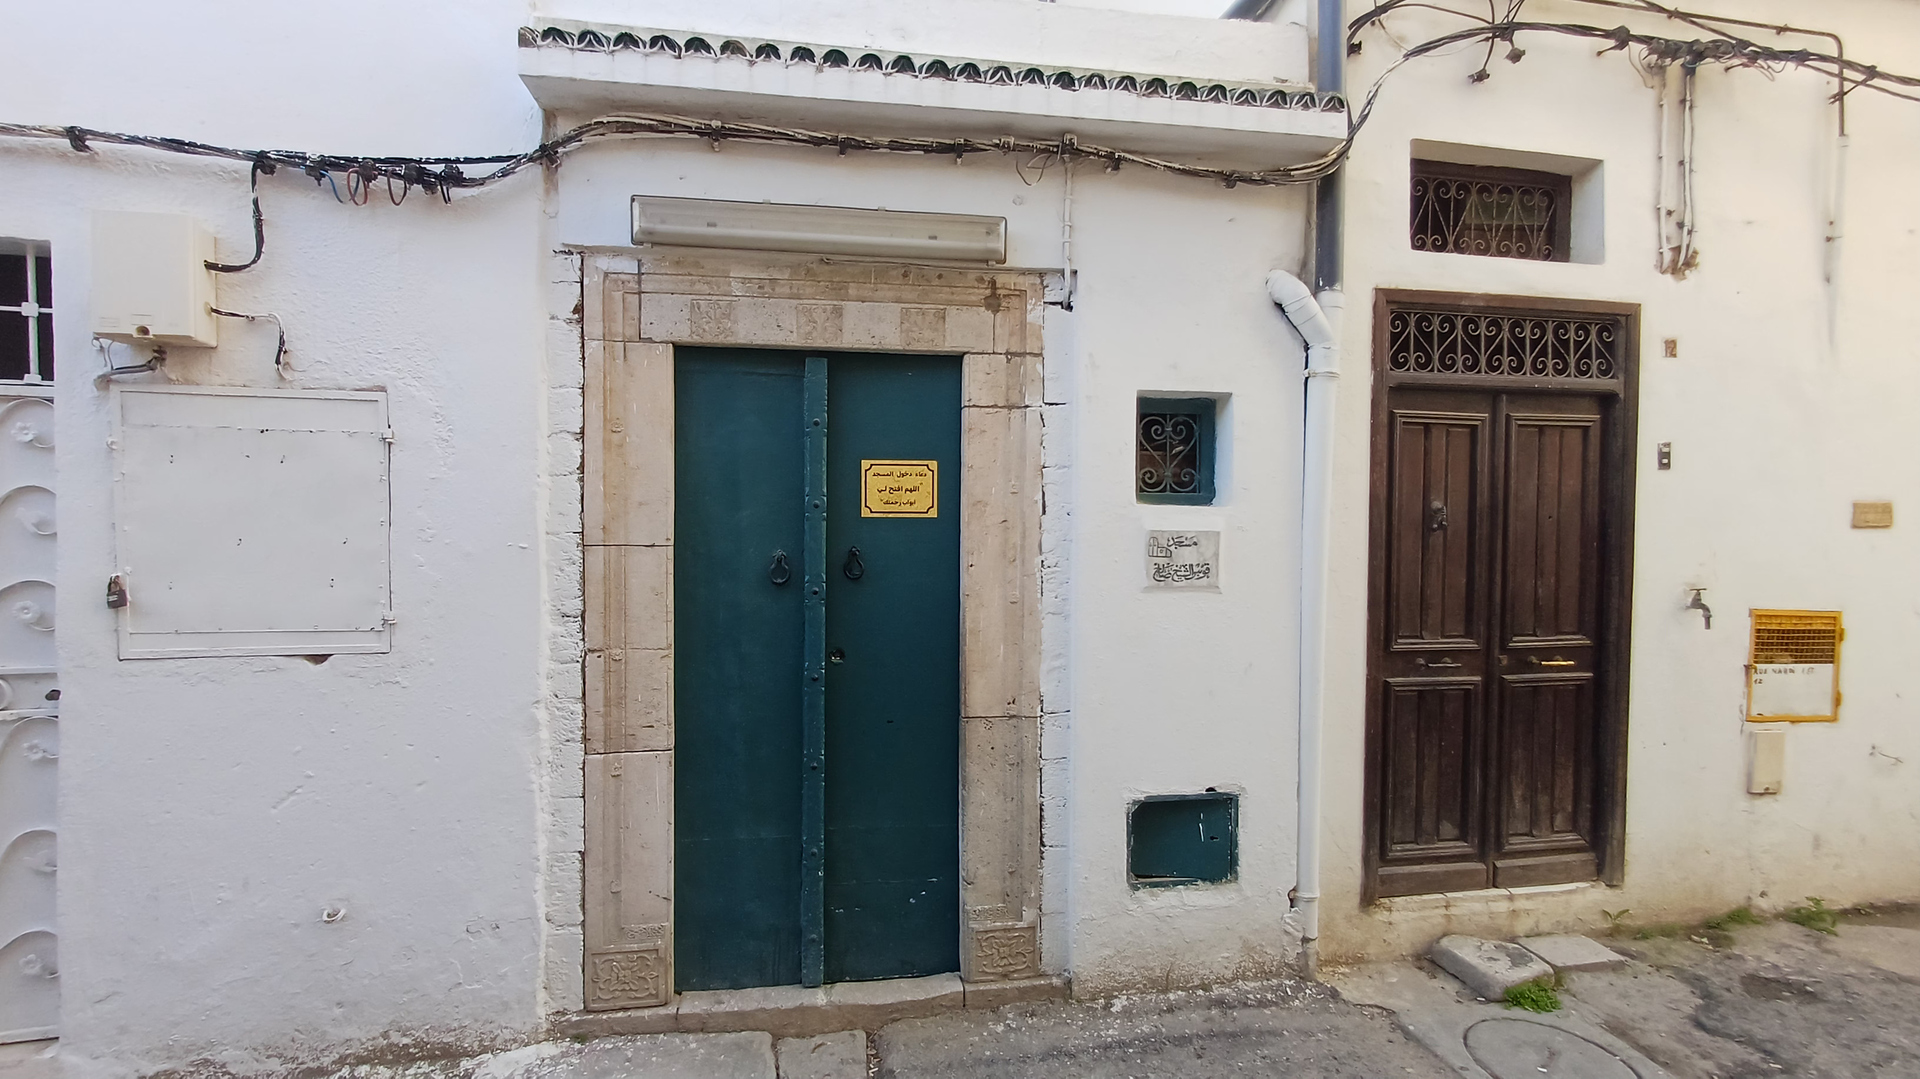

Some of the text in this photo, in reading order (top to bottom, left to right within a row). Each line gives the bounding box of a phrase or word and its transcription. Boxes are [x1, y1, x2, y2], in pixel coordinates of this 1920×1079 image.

[877, 485, 920, 494] اللهم افتح لي
[883, 499, 902, 507] رحمتك
[1166, 535, 1199, 550] مسجد
